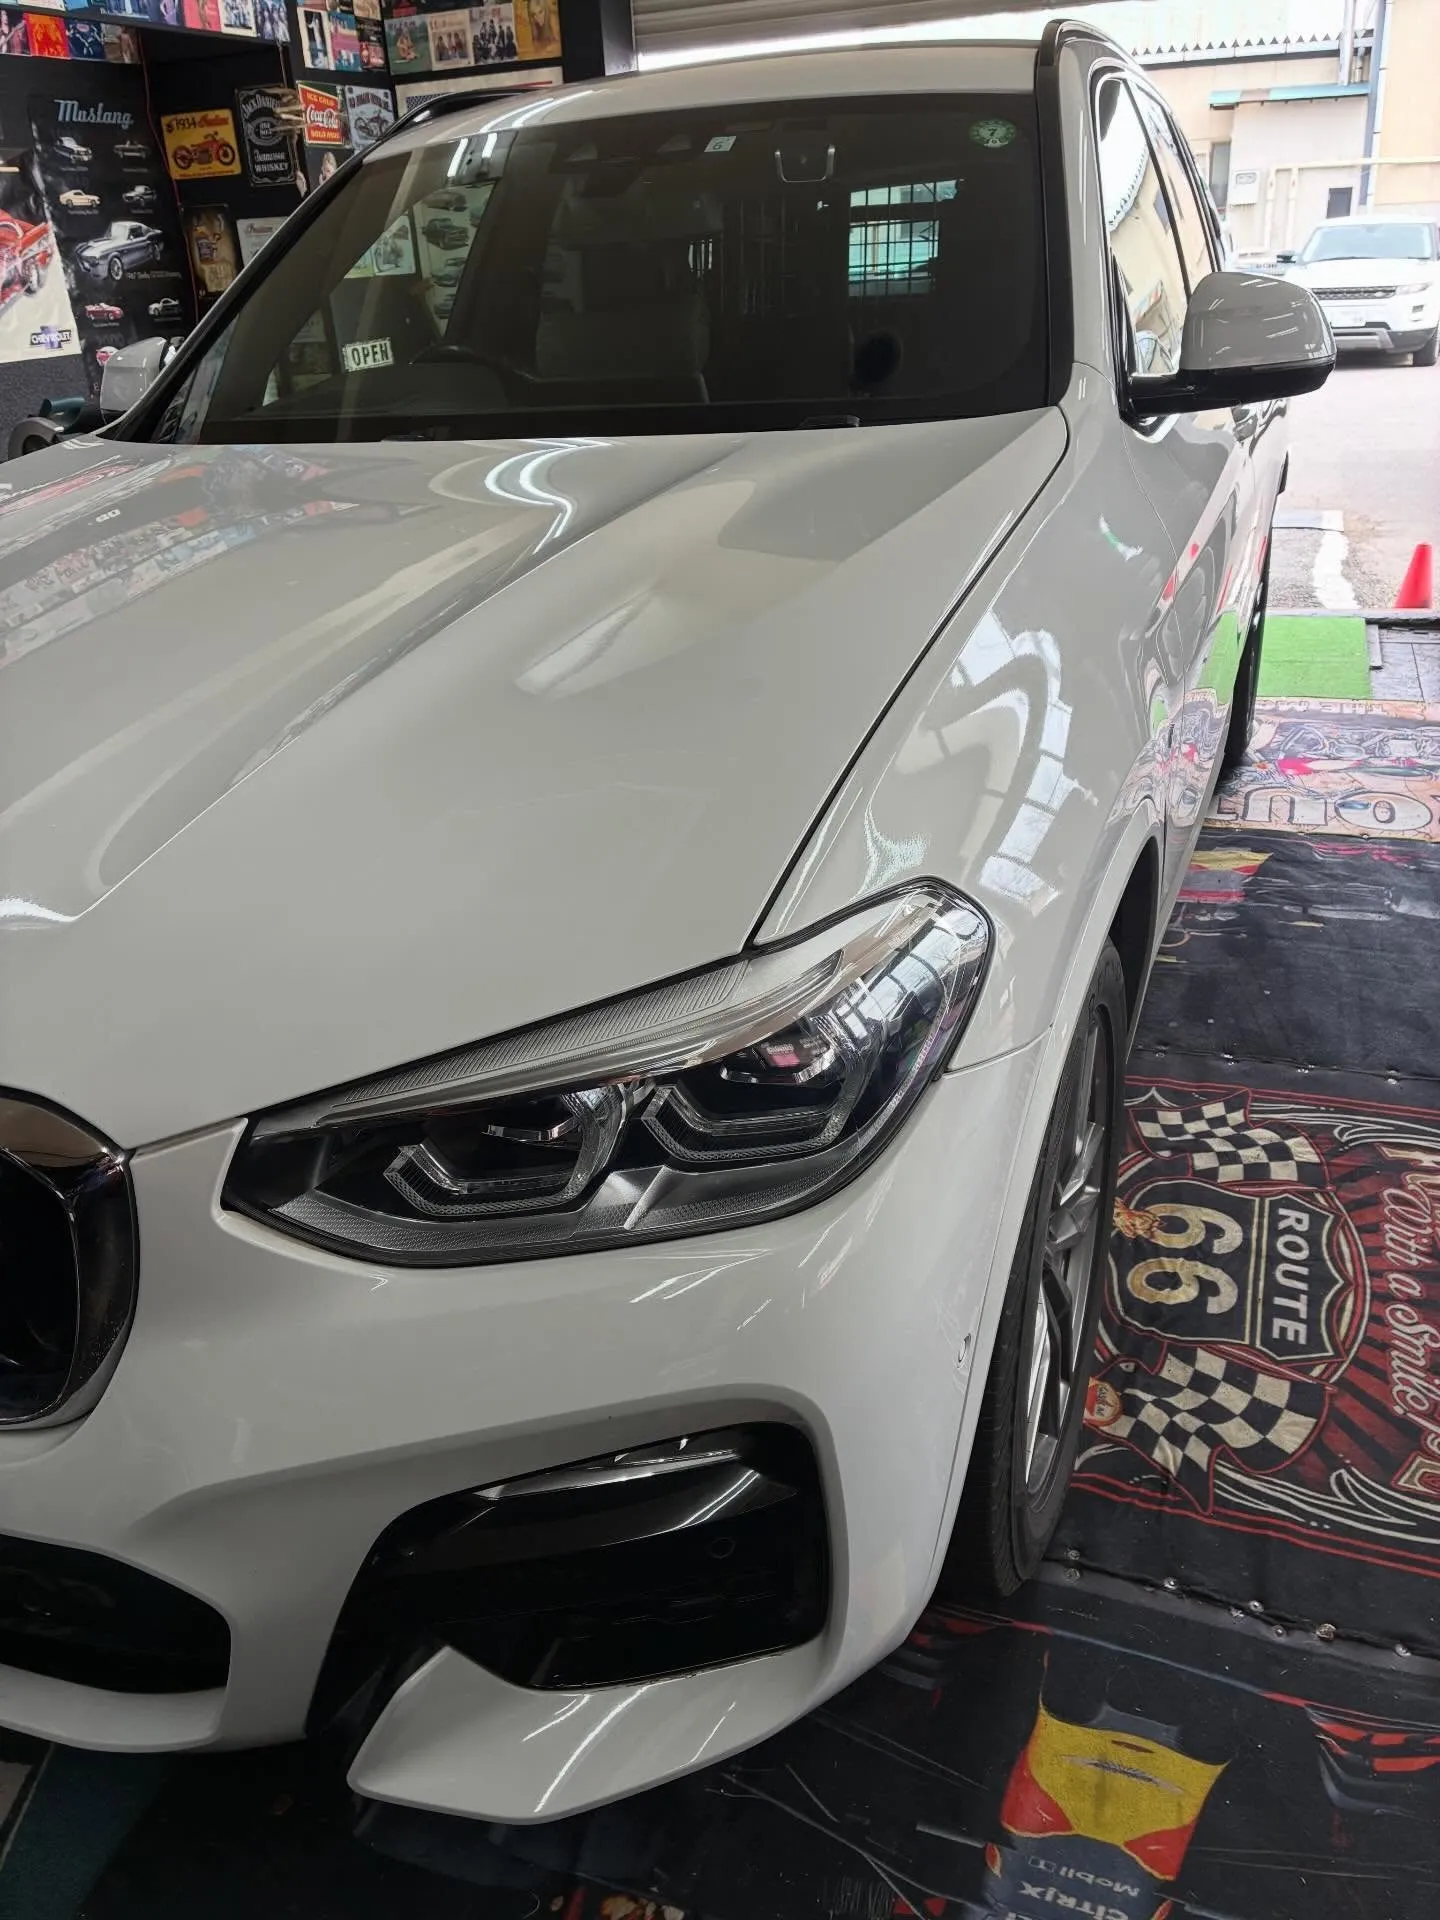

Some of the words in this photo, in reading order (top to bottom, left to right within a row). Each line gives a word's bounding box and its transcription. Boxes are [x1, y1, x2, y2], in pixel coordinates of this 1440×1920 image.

[53, 99, 134, 130] Mustang
[175, 117, 197, 131] 1934
[254, 162, 289, 173] WHISKEY
[351, 342, 389, 367] OPEN
[1383, 1184, 1433, 1267] With
[1118, 1203, 1244, 1315] 66
[1271, 1207, 1311, 1346] ROUTE
[1387, 1273, 1422, 1299] a
[1060, 1866, 1140, 1897] Mobil
